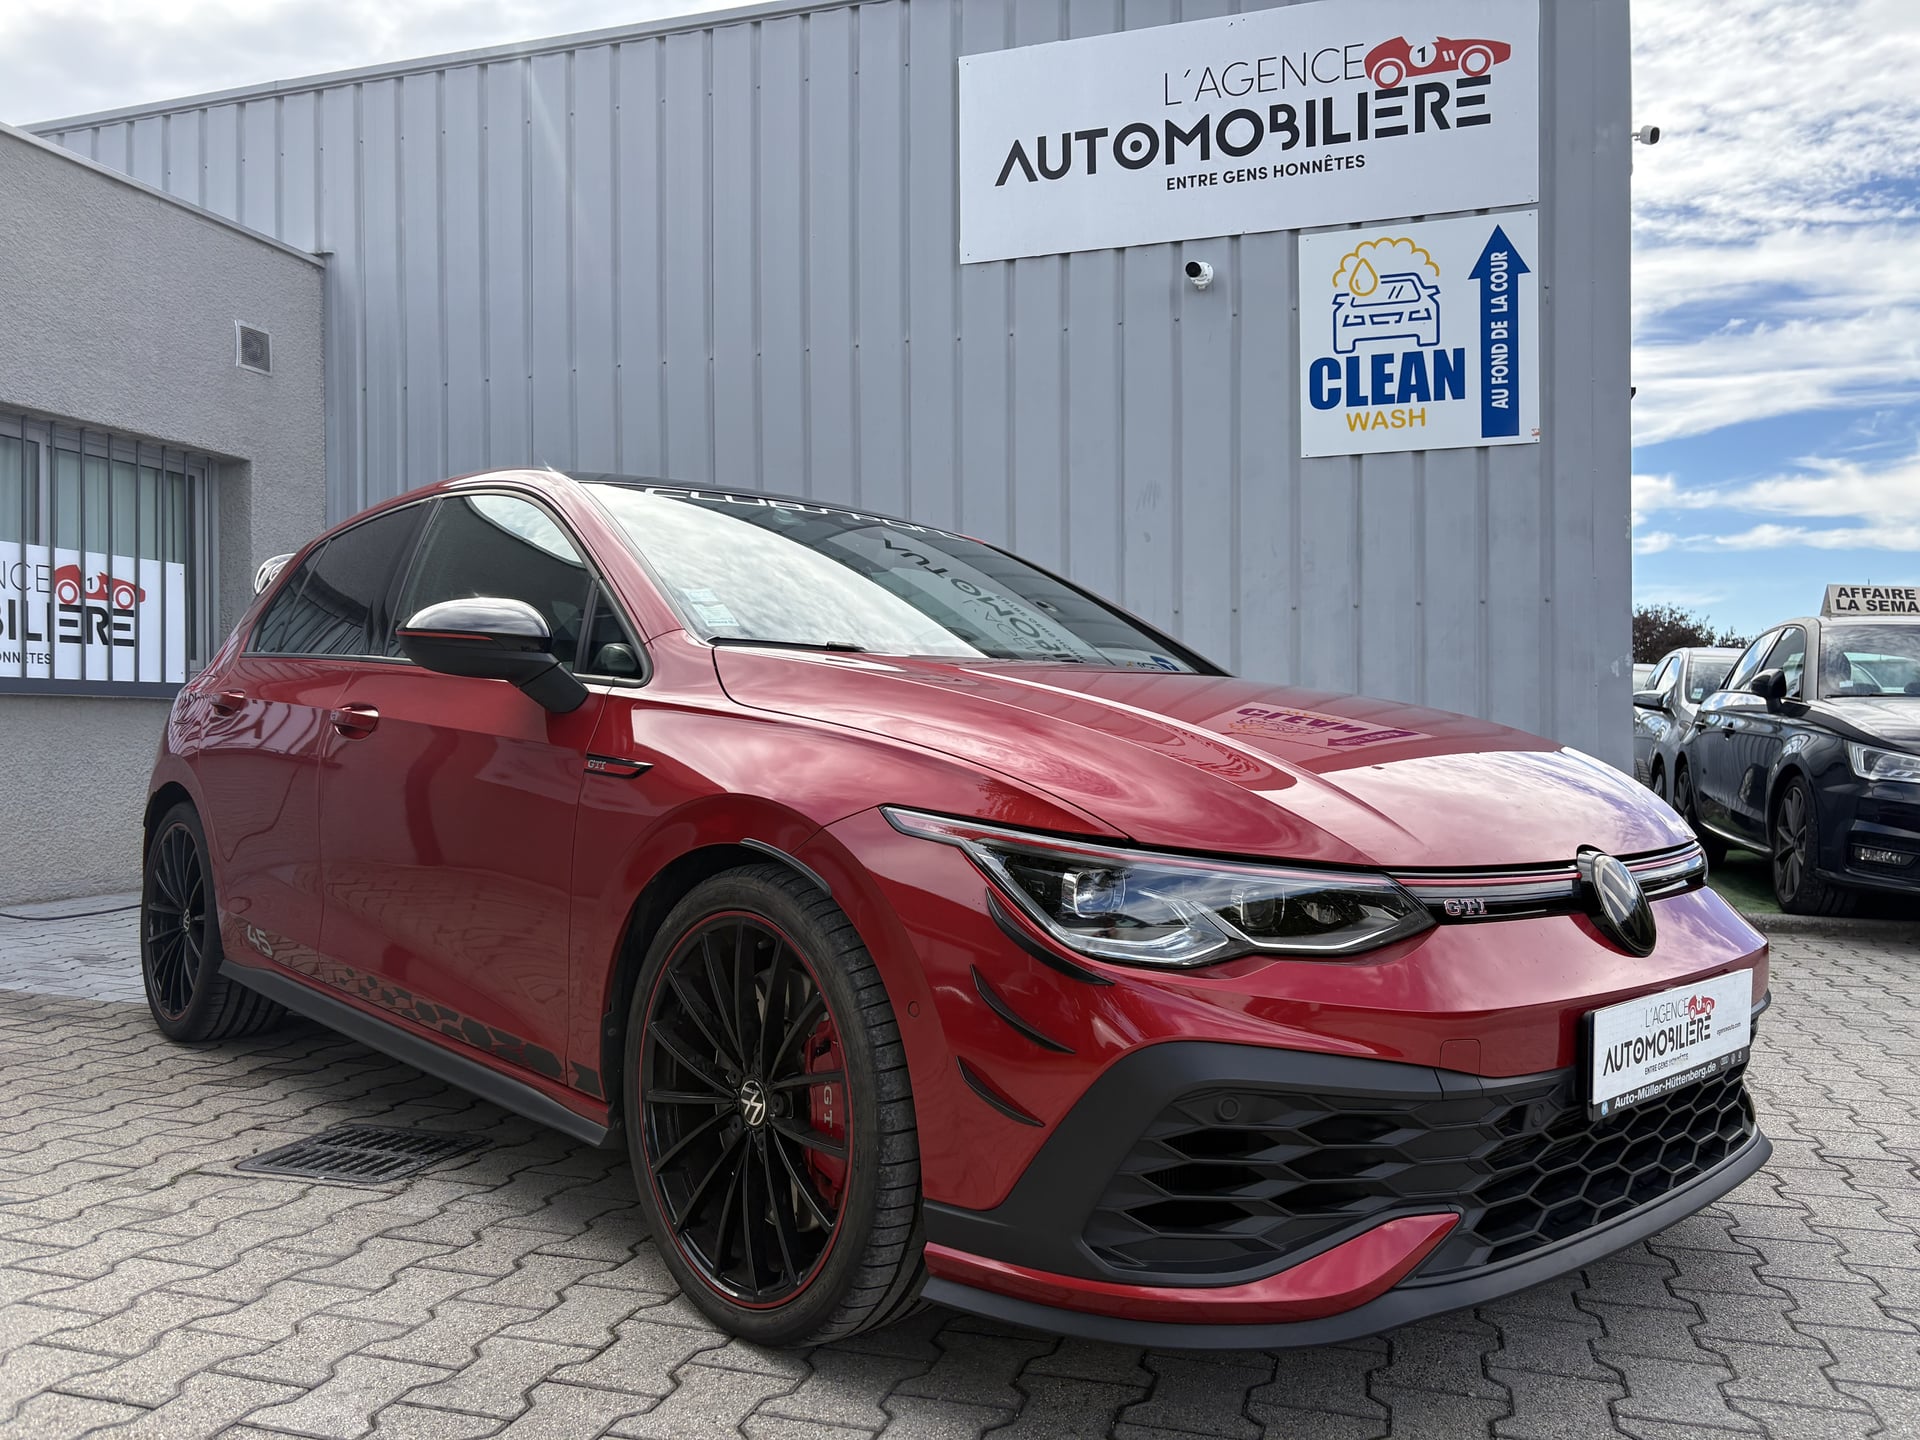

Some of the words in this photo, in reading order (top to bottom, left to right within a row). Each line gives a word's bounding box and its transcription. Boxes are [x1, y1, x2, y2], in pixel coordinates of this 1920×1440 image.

[1166, 172, 1218, 191] ENTRE
[1222, 166, 1268, 184] GENS
[1273, 154, 1366, 178] HONNÊTES
[1490, 251, 1508, 293] COUR
[1491, 294, 1508, 313] LA
[1491, 320, 1508, 340] DE
[1491, 341, 1509, 385] FOND
[1309, 347, 1466, 411] CLEAN
[1491, 386, 1509, 409] AU
[1346, 407, 1427, 432] WASH
[1835, 599, 1860, 611] LA
[1837, 587, 1917, 600] AFFAIRE
[587, 759, 607, 770] GTI
[1443, 898, 1488, 916] GTI
[247, 924, 273, 957] 45
[1613, 1062, 1717, 1109] Auto-Müller-Hüttenberg.de
